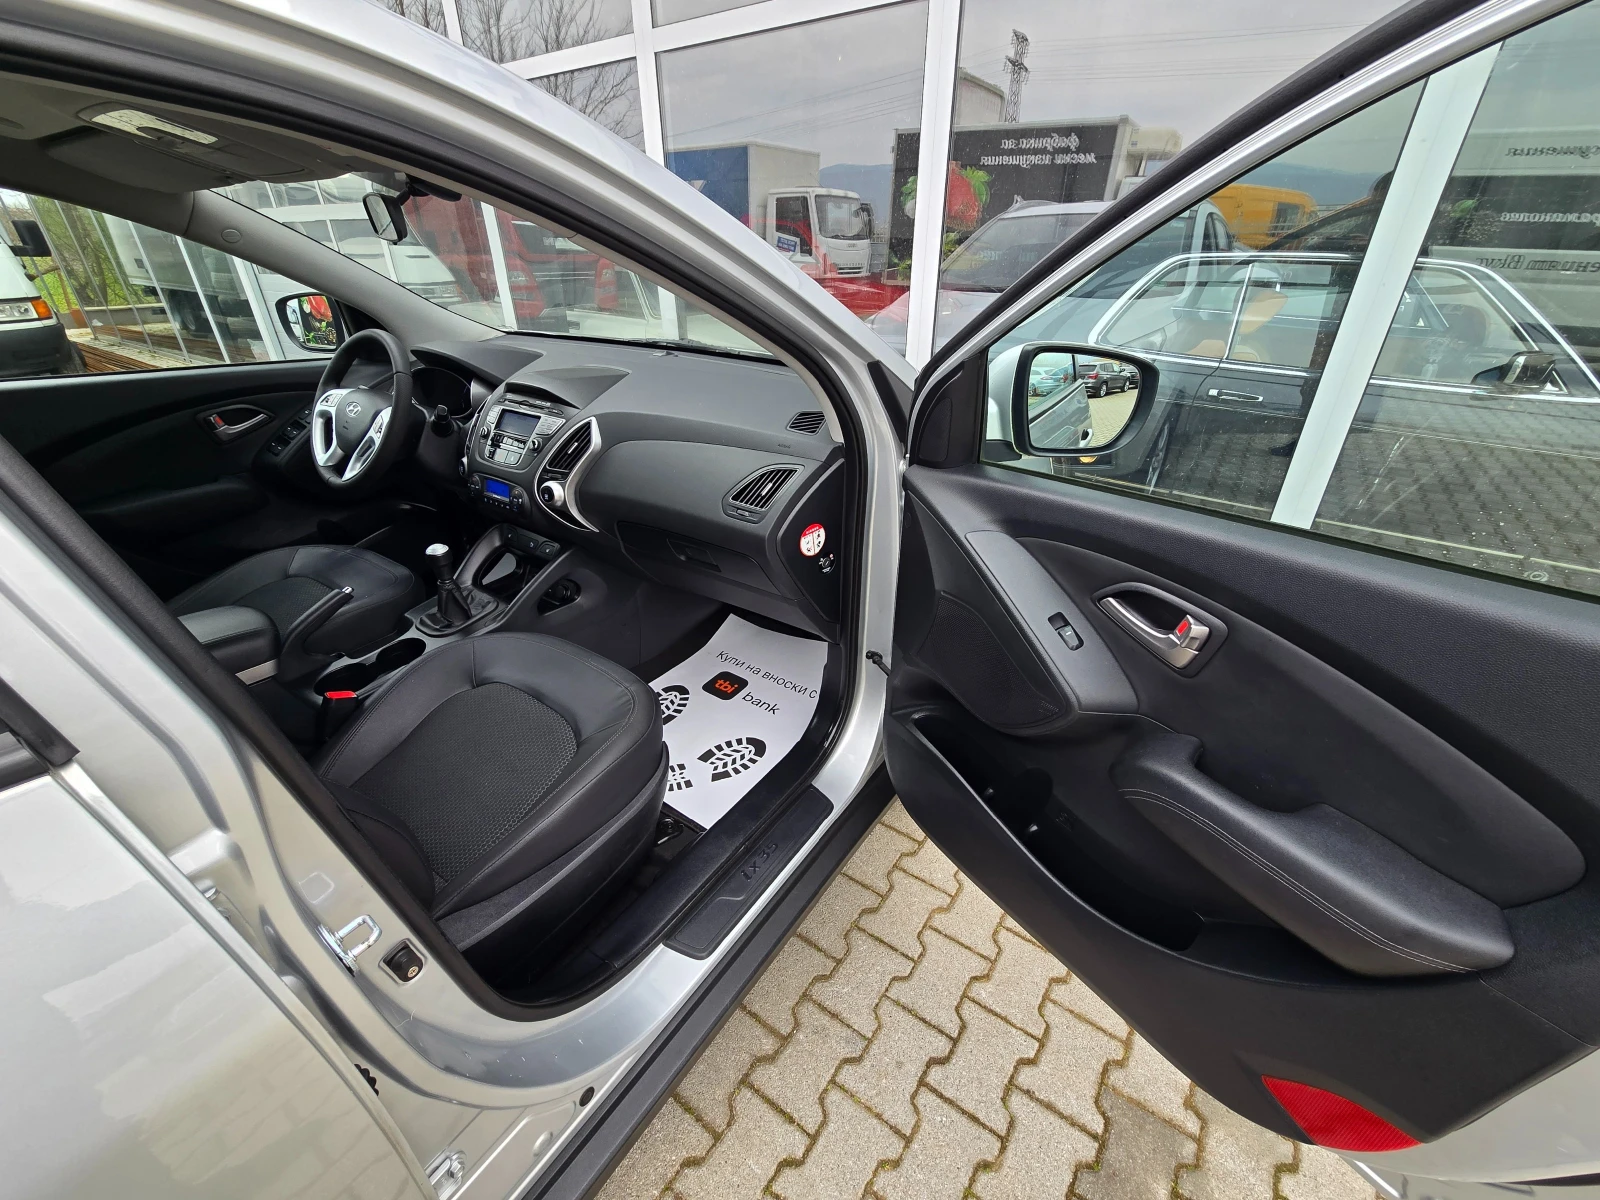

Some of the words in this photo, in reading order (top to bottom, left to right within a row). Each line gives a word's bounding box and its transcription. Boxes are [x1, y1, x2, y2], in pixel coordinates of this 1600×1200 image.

[716, 650, 746, 668] Купи
[745, 664, 762, 675] на
[761, 671, 808, 696] вноски
[714, 679, 739, 694] tbi
[741, 691, 781, 716] bank
